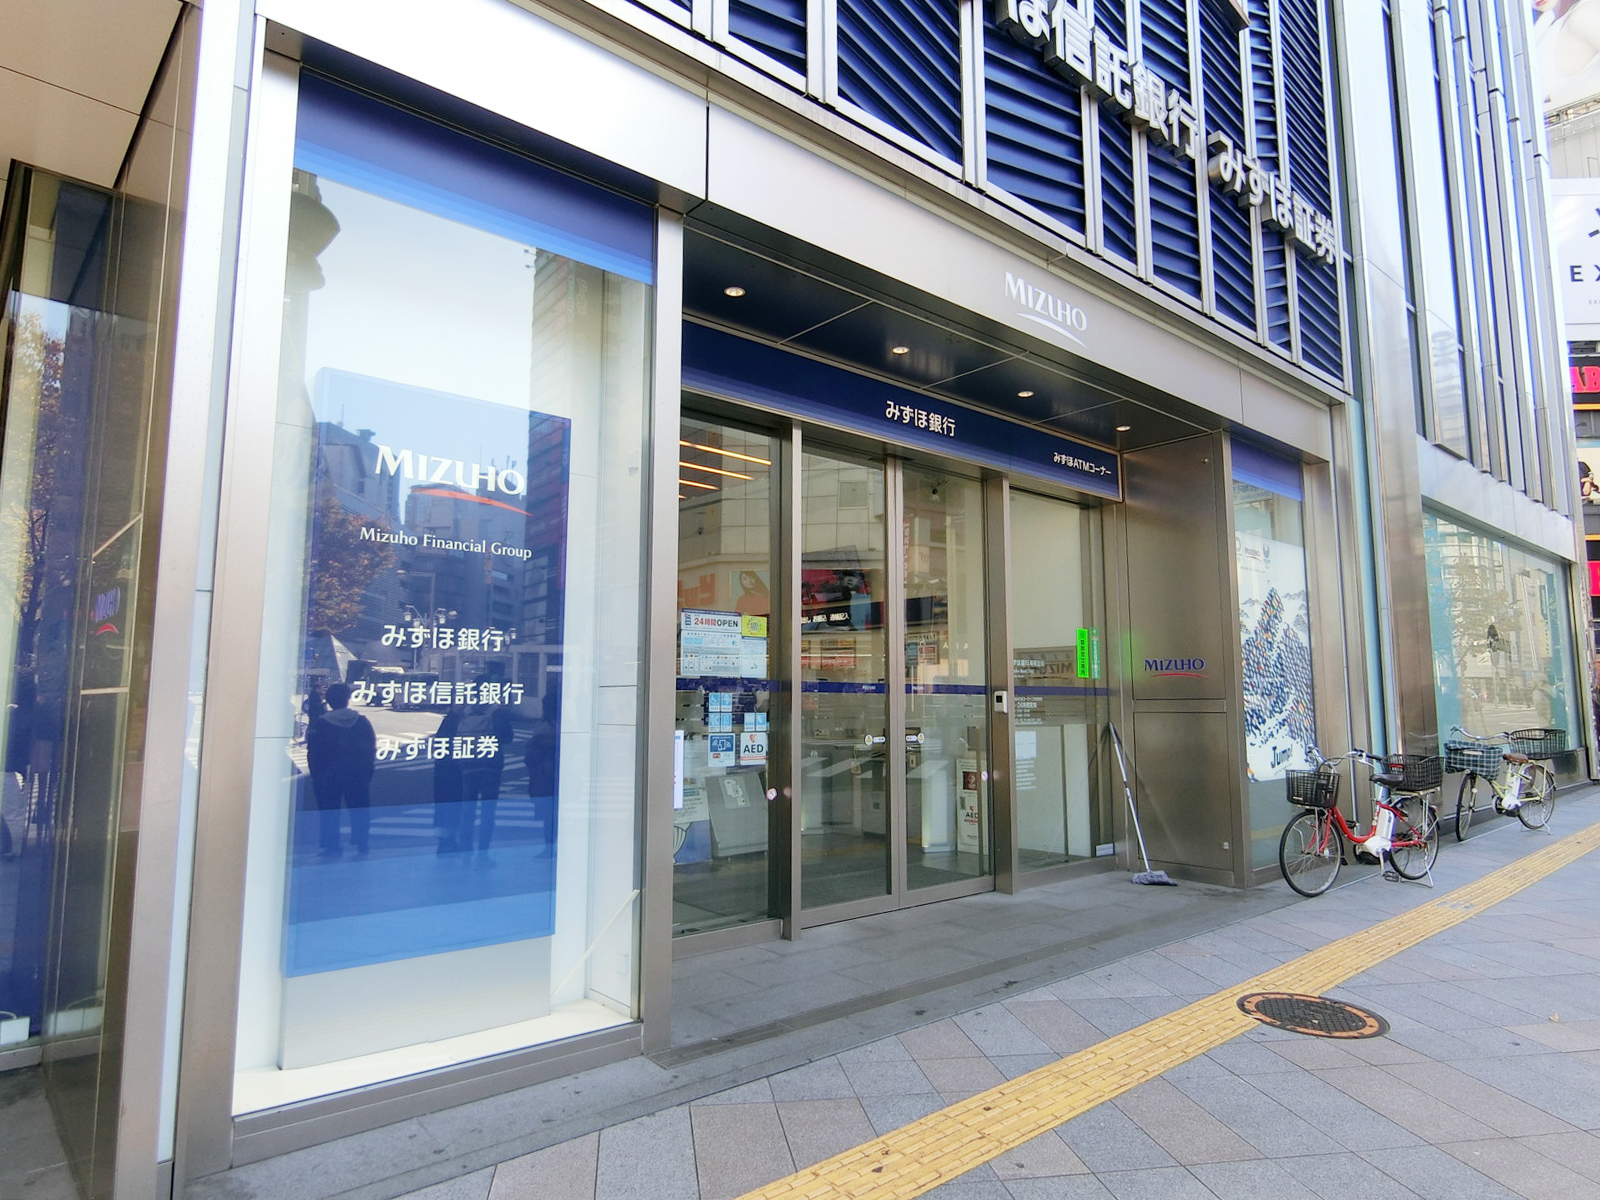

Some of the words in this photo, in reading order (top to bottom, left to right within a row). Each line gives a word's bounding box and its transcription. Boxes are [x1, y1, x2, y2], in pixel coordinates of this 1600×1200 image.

[1210, 131, 1336, 265] みずほ証券
[1004, 272, 1088, 331] MIZUHO
[885, 399, 956, 437] みずほ銀行
[375, 444, 526, 496] MIZUHO
[1053, 451, 1112, 476] みずほATMコーナー
[359, 526, 418, 547] Mizuho
[422, 533, 487, 554] Financial
[490, 540, 533, 560] Group
[693, 617, 739, 628] 24時間OPEN
[381, 623, 505, 653] みずほ銀行
[1144, 658, 1206, 672] MIZUHO
[351, 679, 525, 707] みずほ信託銀行
[376, 735, 500, 761] みずほ証券
[743, 744, 764, 754] AED
